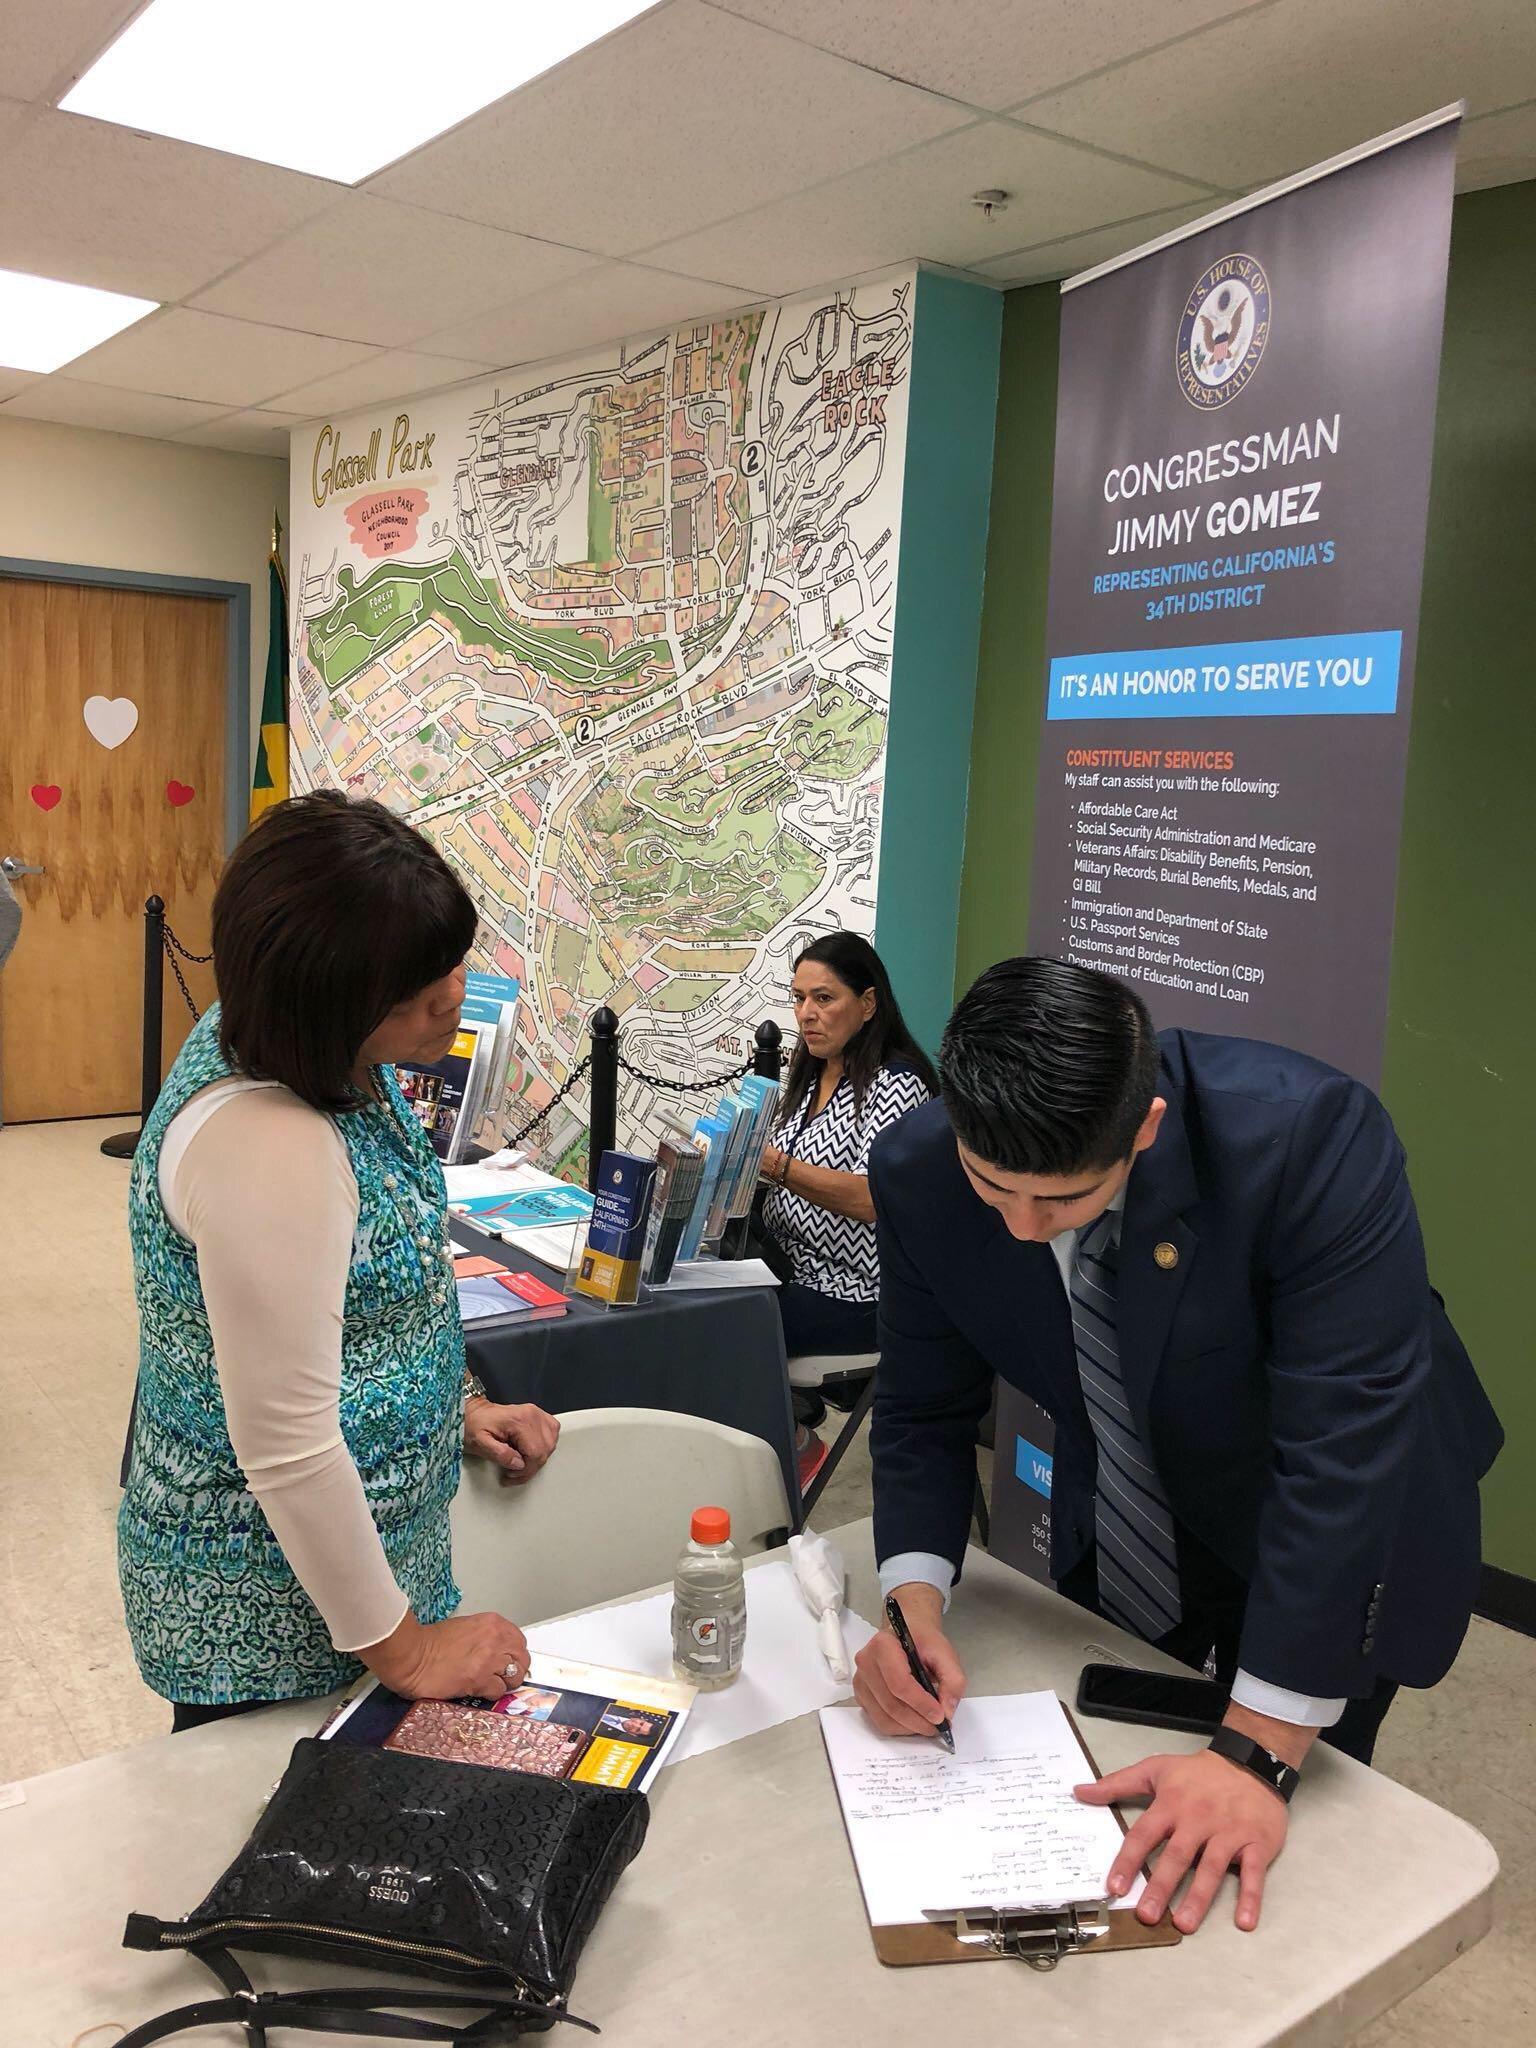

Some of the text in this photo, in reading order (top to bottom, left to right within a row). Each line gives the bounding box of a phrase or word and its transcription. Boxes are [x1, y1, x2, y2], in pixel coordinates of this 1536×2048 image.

[1185, 257, 1267, 318] U.S. HOUSE OF
[1177, 320, 1267, 405] REPRESENTATIVES
[820, 357, 897, 401] EAGLE
[678, 395, 704, 406] PALMER
[824, 394, 889, 433] ROCK
[312, 413, 436, 508] Glassell Park
[746, 445, 759, 474] 2
[1104, 414, 1341, 503] CONGRESSMAN
[500, 459, 557, 490] GLENDALE
[361, 495, 415, 523] GLASSELL PARK
[368, 515, 409, 534] NEIGHBORHOOD
[1108, 481, 1323, 556] JIMMY GOMEZ
[376, 530, 401, 542] COUNCIL
[664, 518, 673, 572] ROAD
[1093, 540, 1337, 595] REPRESENTING CALIFORNIA'S
[369, 589, 394, 609] FOREST
[686, 595, 710, 606] YORK
[715, 587, 736, 599] BLVD
[800, 568, 855, 601] YORK BLVD
[374, 602, 393, 619] LAWN
[554, 607, 615, 619] YORK BLVD
[1145, 583, 1266, 622] 34TH DISTRICT
[828, 672, 878, 706] EL PASO DR
[1060, 656, 1374, 699] IT'S AN HONOR TO SERVE YOU
[617, 683, 679, 722] GLENDALE FWY
[628, 685, 748, 748] EAGLE ROCK BLVD
[403, 725, 421, 740] DRIVE
[579, 718, 590, 741] 2
[756, 710, 793, 729] TOLAND WAY
[653, 760, 687, 777] TOLAND WAY
[1066, 749, 1235, 771] CONSTITUENT SERVICES
[1065, 773, 1281, 798] My staff can assist you with the following:
[1078, 802, 1178, 820] Affordable Care Act
[783, 822, 814, 847] DIVISION
[1076, 820, 1317, 855] Social Security Administration and Medicare
[479, 842, 496, 861] MOSS
[1075, 840, 1314, 879] Veterans Affairs: Disability Benefits, Pension,
[1072, 878, 1102, 895] GI Bill
[1074, 859, 1317, 902] Military Records, Burial Benefits, Medals, and
[526, 802, 551, 1024] EAGLE ROCK BLVD
[1071, 897, 1268, 941] Immigration and Department of State
[1069, 915, 1181, 947] U.S. Passport Services
[1068, 934, 1266, 985] Customs and Border Protection (CBP)
[604, 974, 629, 1001] CAZADOR
[681, 972, 749, 1021] DIVISION ST.
[1130, 965, 1142, 980] of
[1143, 967, 1194, 991] Education
[1195, 977, 1218, 997] and
[1219, 983, 1250, 1004] Loan
[715, 1034, 743, 1058] MT.
[596, 1196, 620, 1212] GUIDE
[591, 1218, 607, 1231] 34TH
[1031, 1523, 1046, 1539] 350
[593, 1743, 622, 1785] JIMMY
